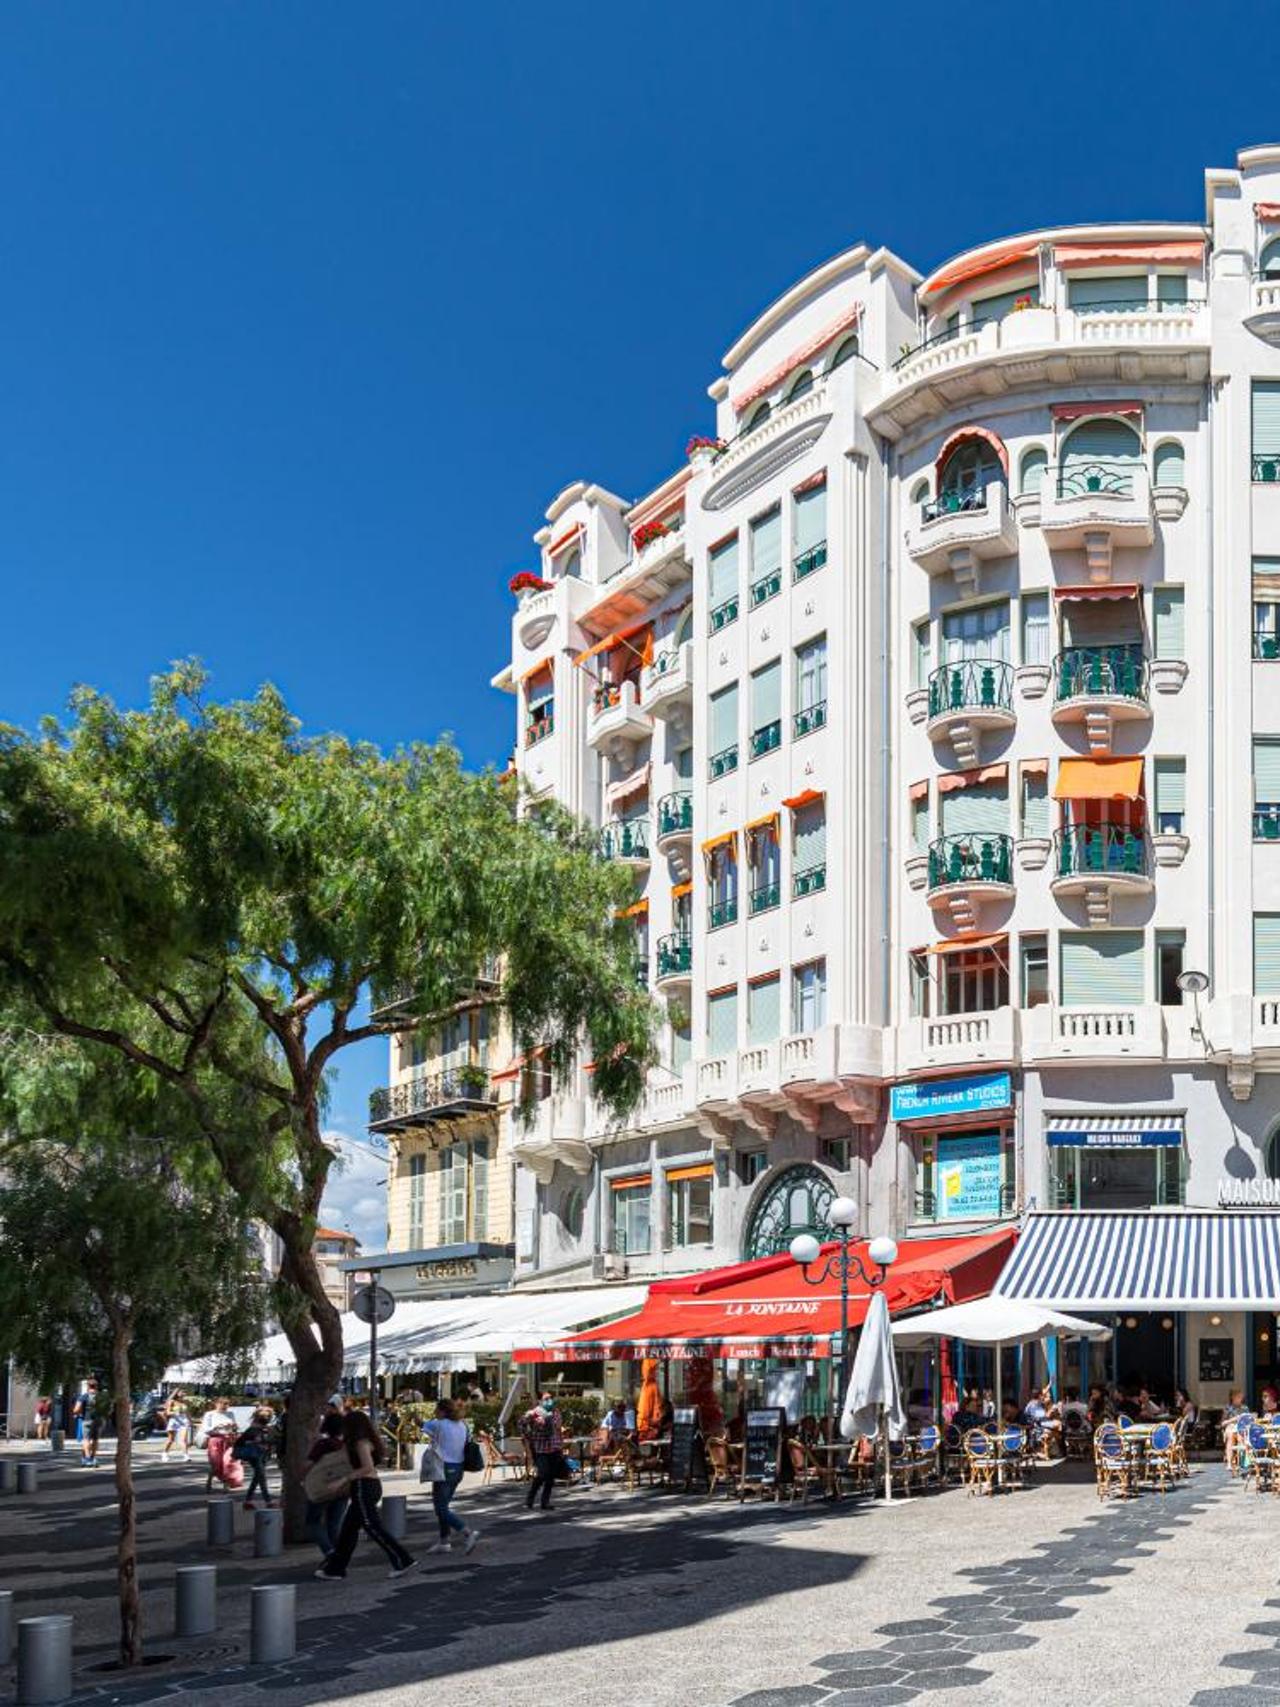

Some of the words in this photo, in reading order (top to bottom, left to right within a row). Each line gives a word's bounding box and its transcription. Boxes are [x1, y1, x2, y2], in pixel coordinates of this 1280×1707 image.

[967, 1084, 1006, 1101] STUDIOS
[725, 1304, 744, 1316] LA
[747, 1301, 821, 1315] FONTAINE
